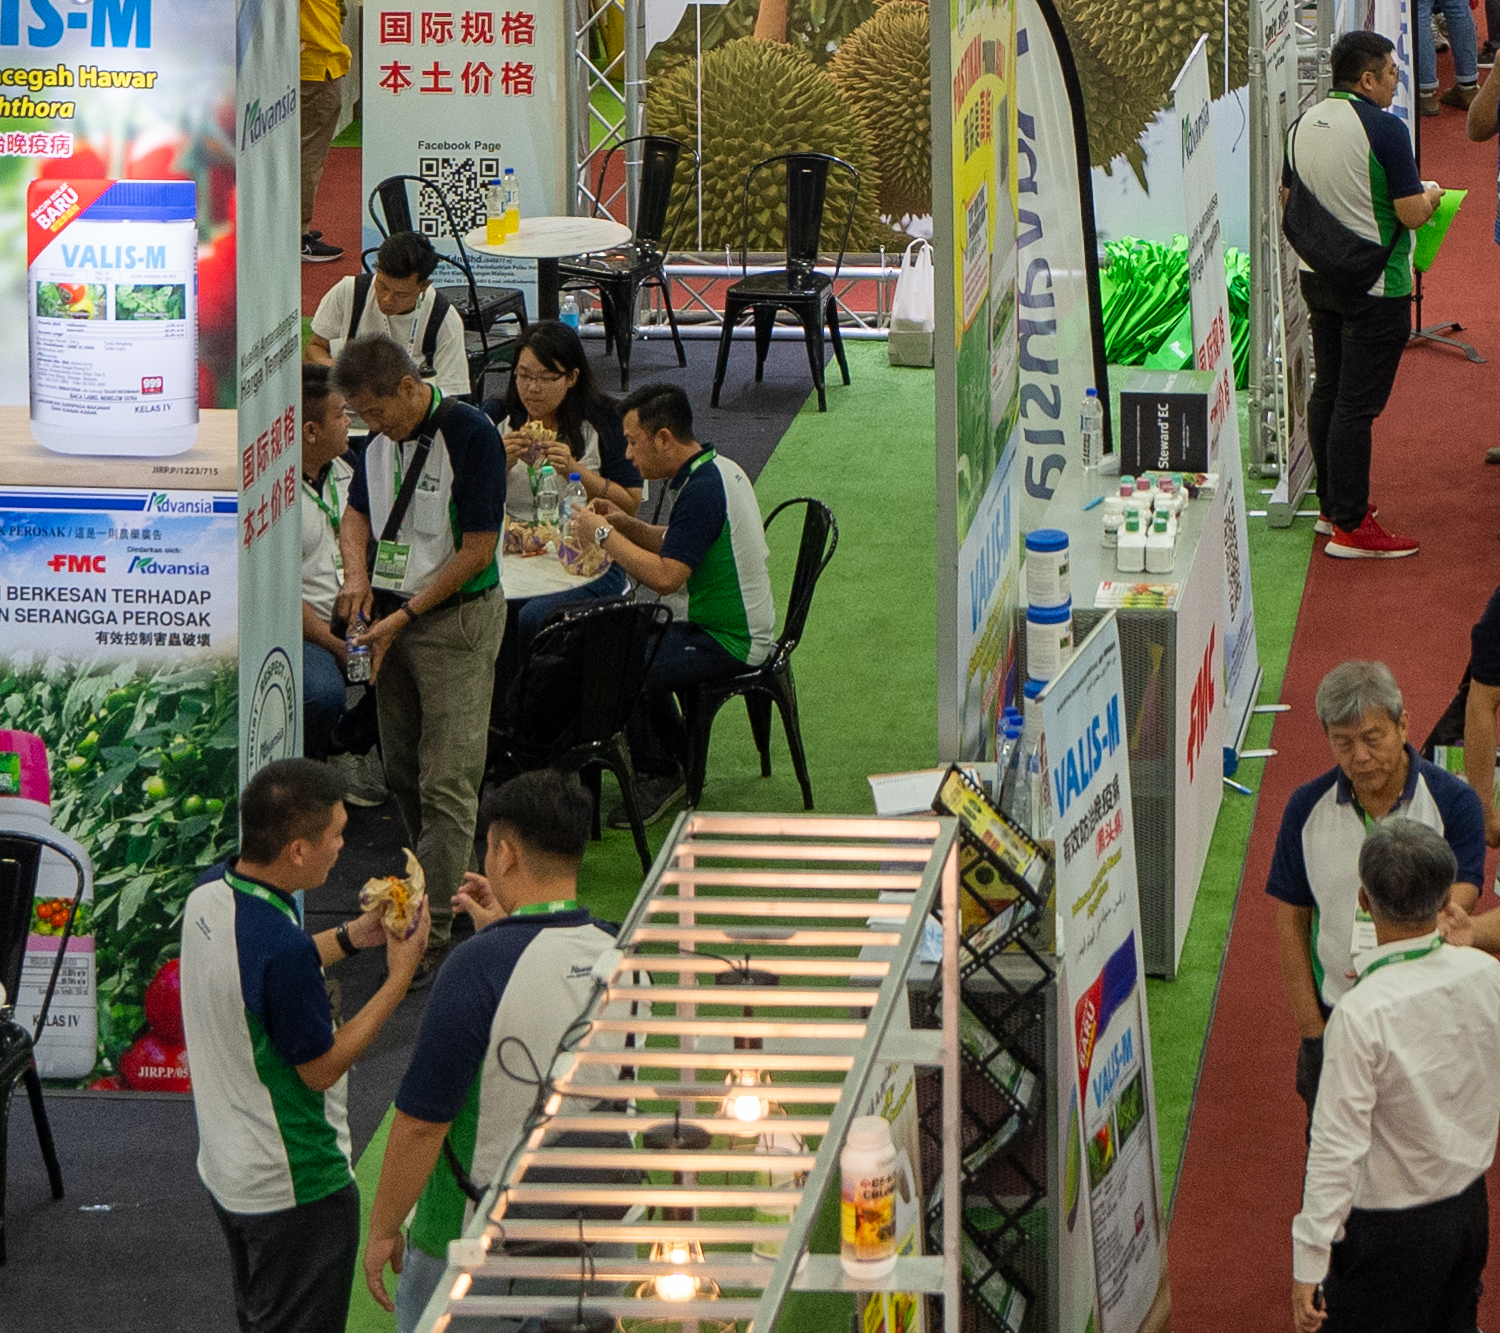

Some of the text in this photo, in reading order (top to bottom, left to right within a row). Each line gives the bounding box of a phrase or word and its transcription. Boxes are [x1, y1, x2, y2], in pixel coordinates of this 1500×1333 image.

[379, 10, 536, 46] 国际规格
[78, 65, 158, 90] Hawar
[378, 60, 536, 96] 本土价格
[241, 85, 297, 152] Advansia
[417, 140, 502, 153] Facebook Page
[36, 186, 80, 231] BARU
[61, 244, 166, 269] VALIS-M
[242, 404, 296, 492] 国际规格
[142, 492, 213, 514] Advansia
[242, 463, 296, 550] 本土价格
[9, 525, 66, 538] PEROSAK
[47, 554, 107, 575] FMC
[126, 556, 210, 577] Advansia
[6, 586, 108, 603] BERKESAN
[111, 588, 212, 606] TERHADAP
[14, 608, 118, 626] SERANGGA
[122, 610, 211, 628] PEROSAK
[1053, 697, 1122, 819] VALIS-M
